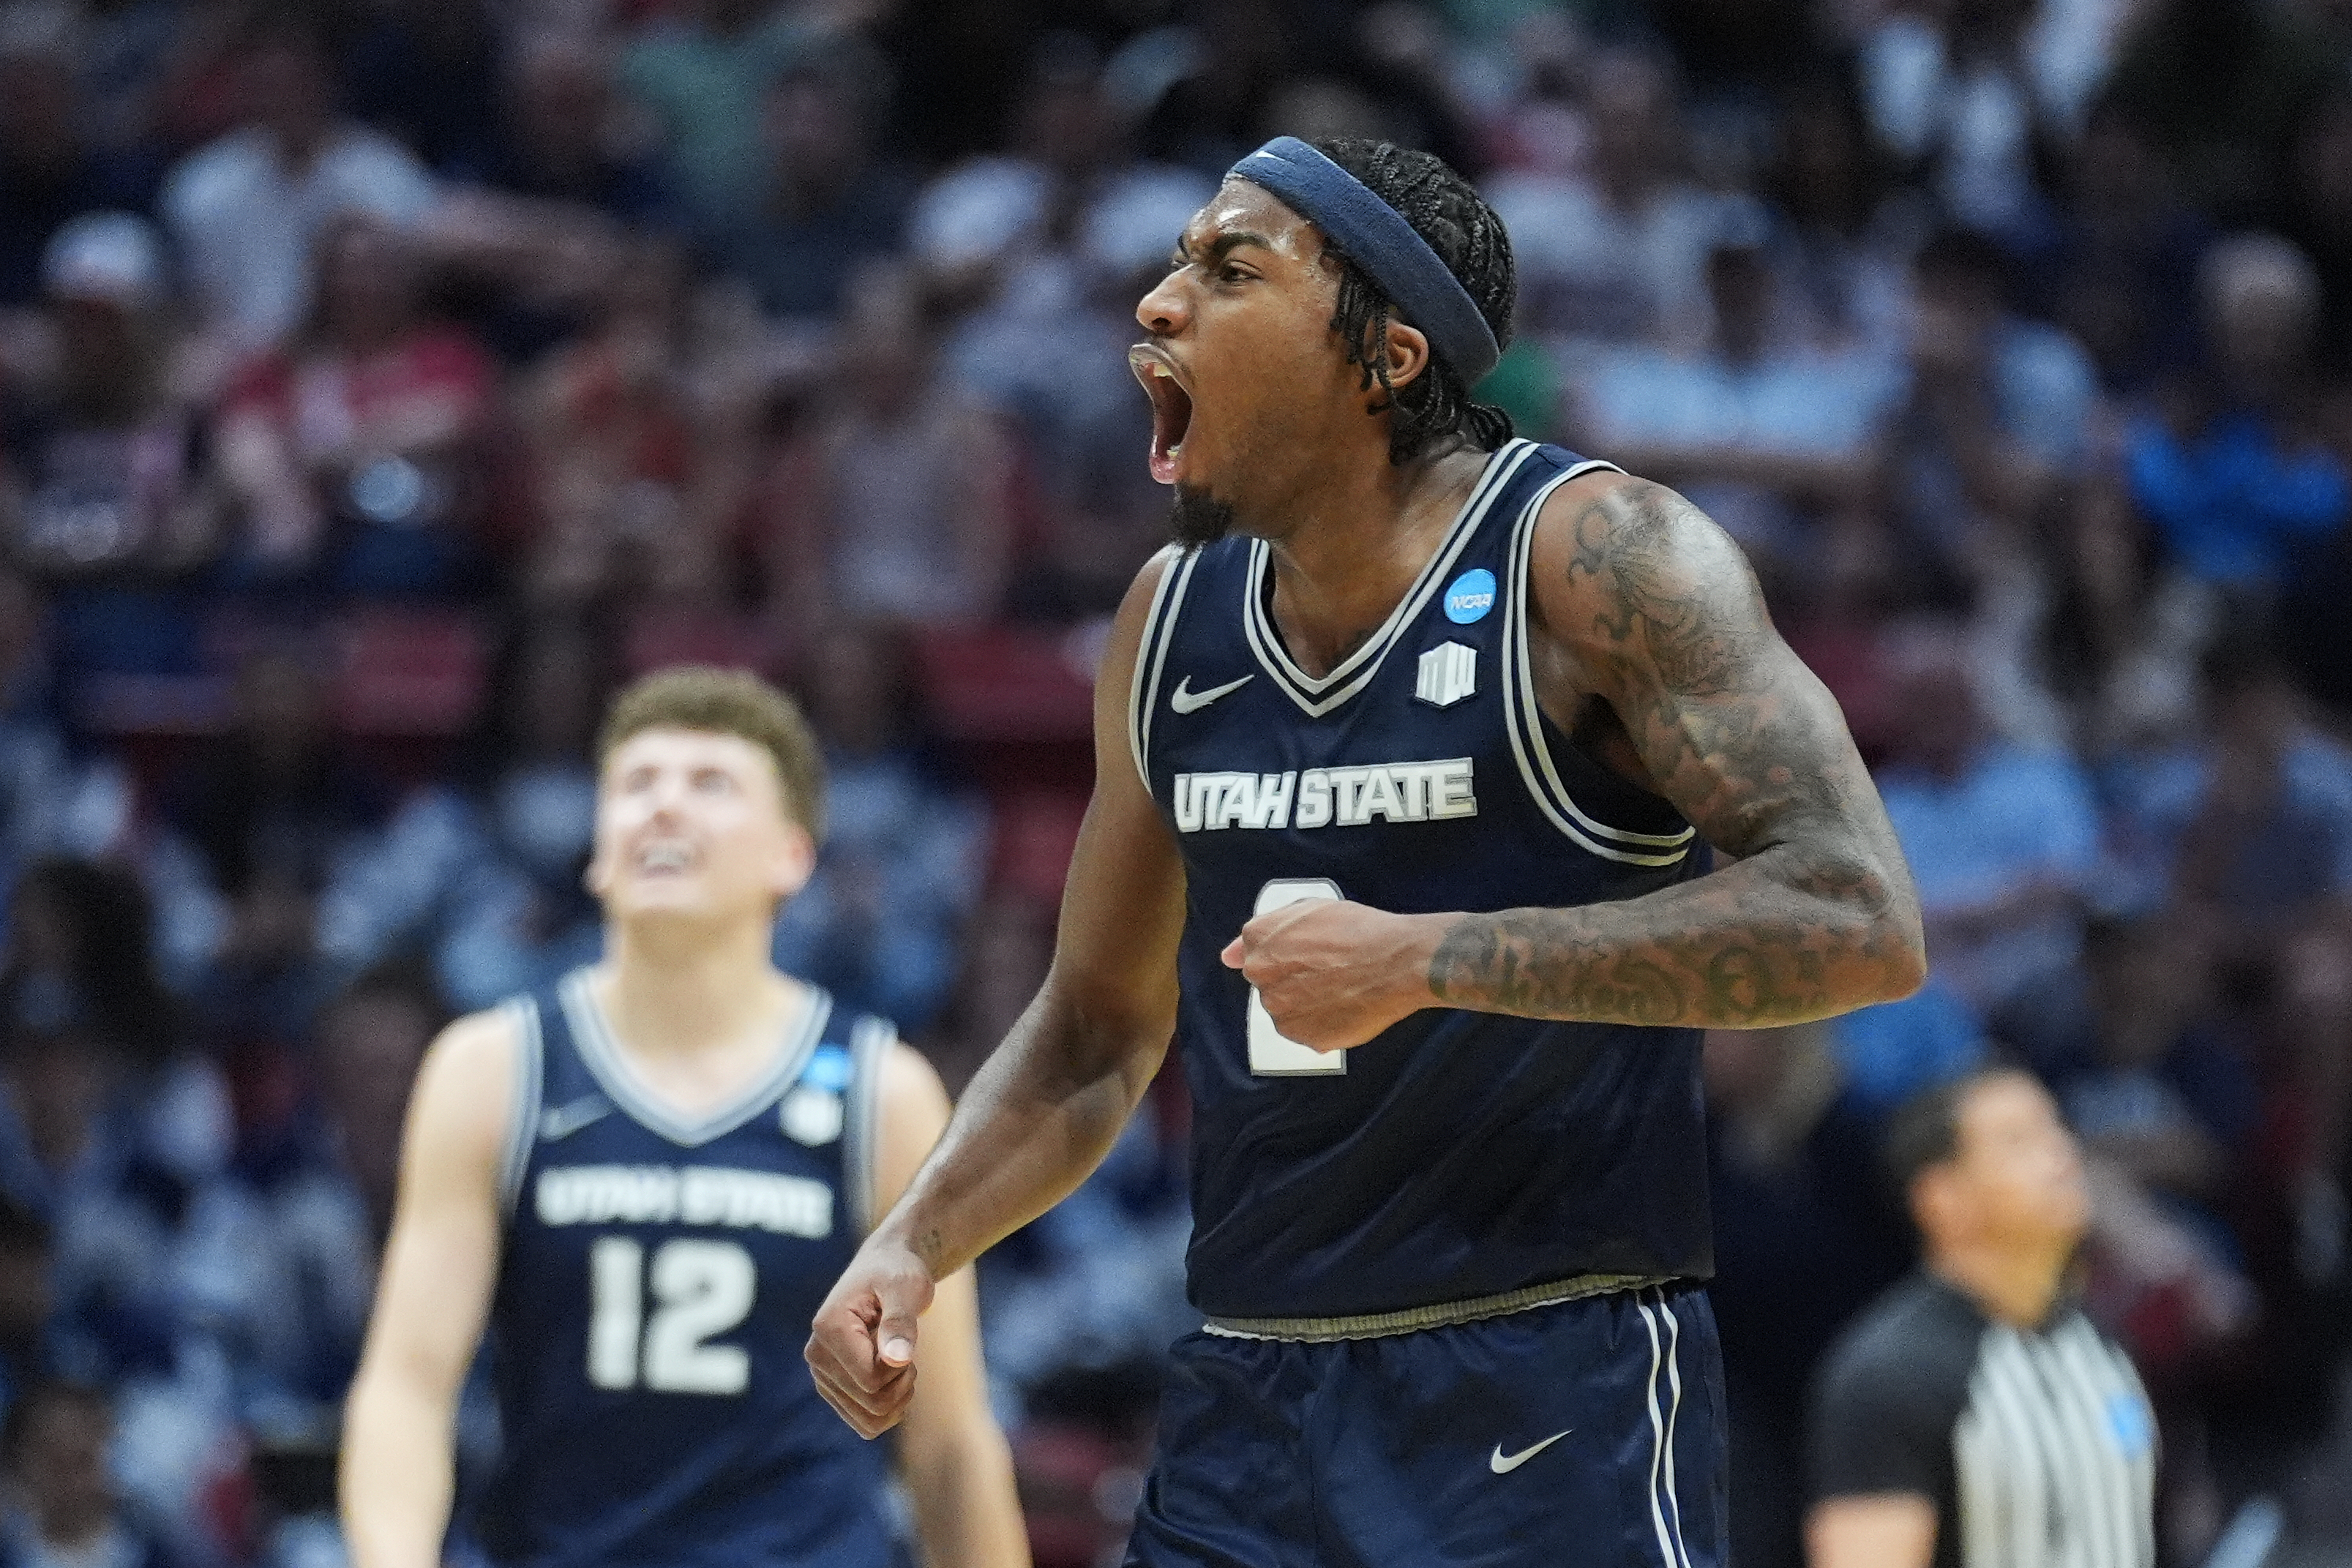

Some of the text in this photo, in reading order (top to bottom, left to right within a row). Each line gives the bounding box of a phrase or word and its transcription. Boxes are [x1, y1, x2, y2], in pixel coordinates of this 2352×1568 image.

[1451, 593, 1493, 610] NCAA
[1175, 757, 1478, 833] UTAH STATE
[588, 1236, 756, 1394] 12
